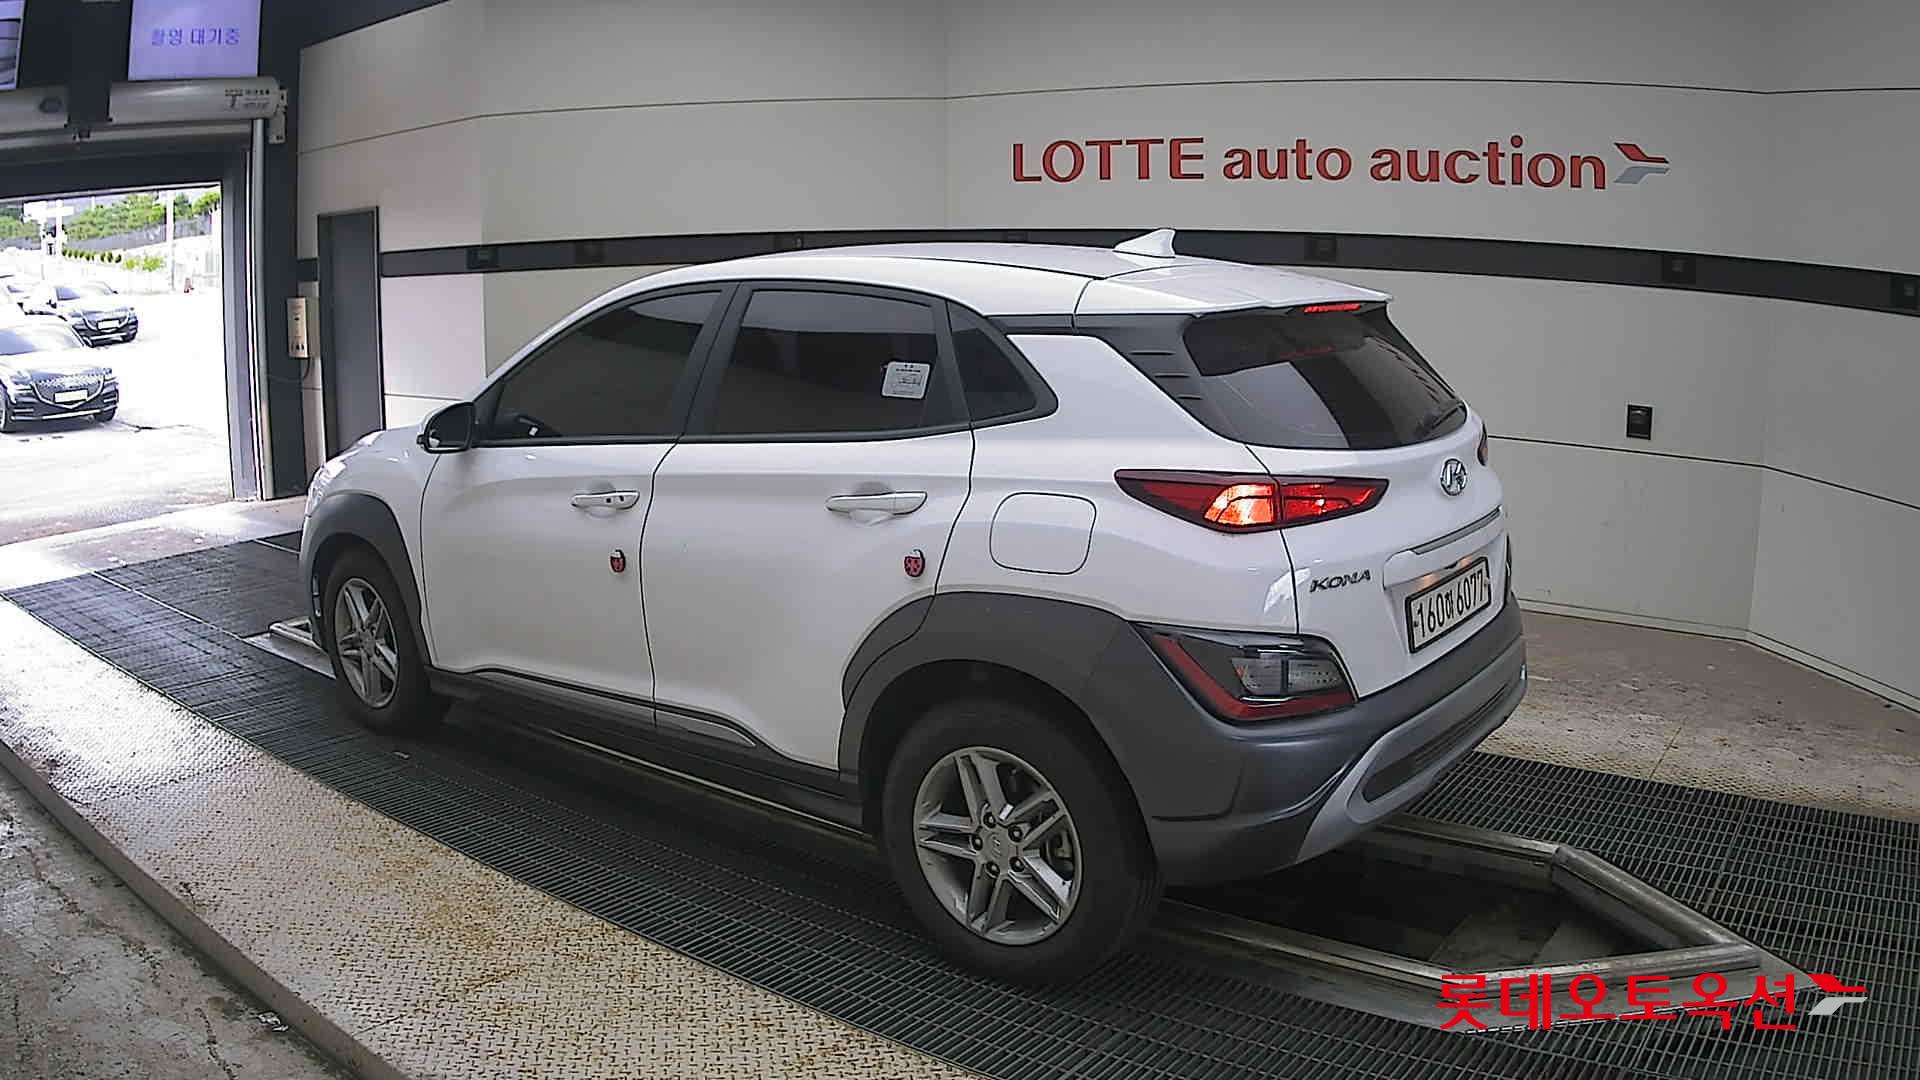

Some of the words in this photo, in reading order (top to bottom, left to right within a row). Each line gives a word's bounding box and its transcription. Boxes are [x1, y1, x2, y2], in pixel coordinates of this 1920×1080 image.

[190, 27, 240, 46] 대기중
[1013, 137, 1204, 182] LOTTE
[1223, 139, 1352, 181] auto
[1370, 135, 1606, 189] auction
[1310, 569, 1371, 593] KONA
